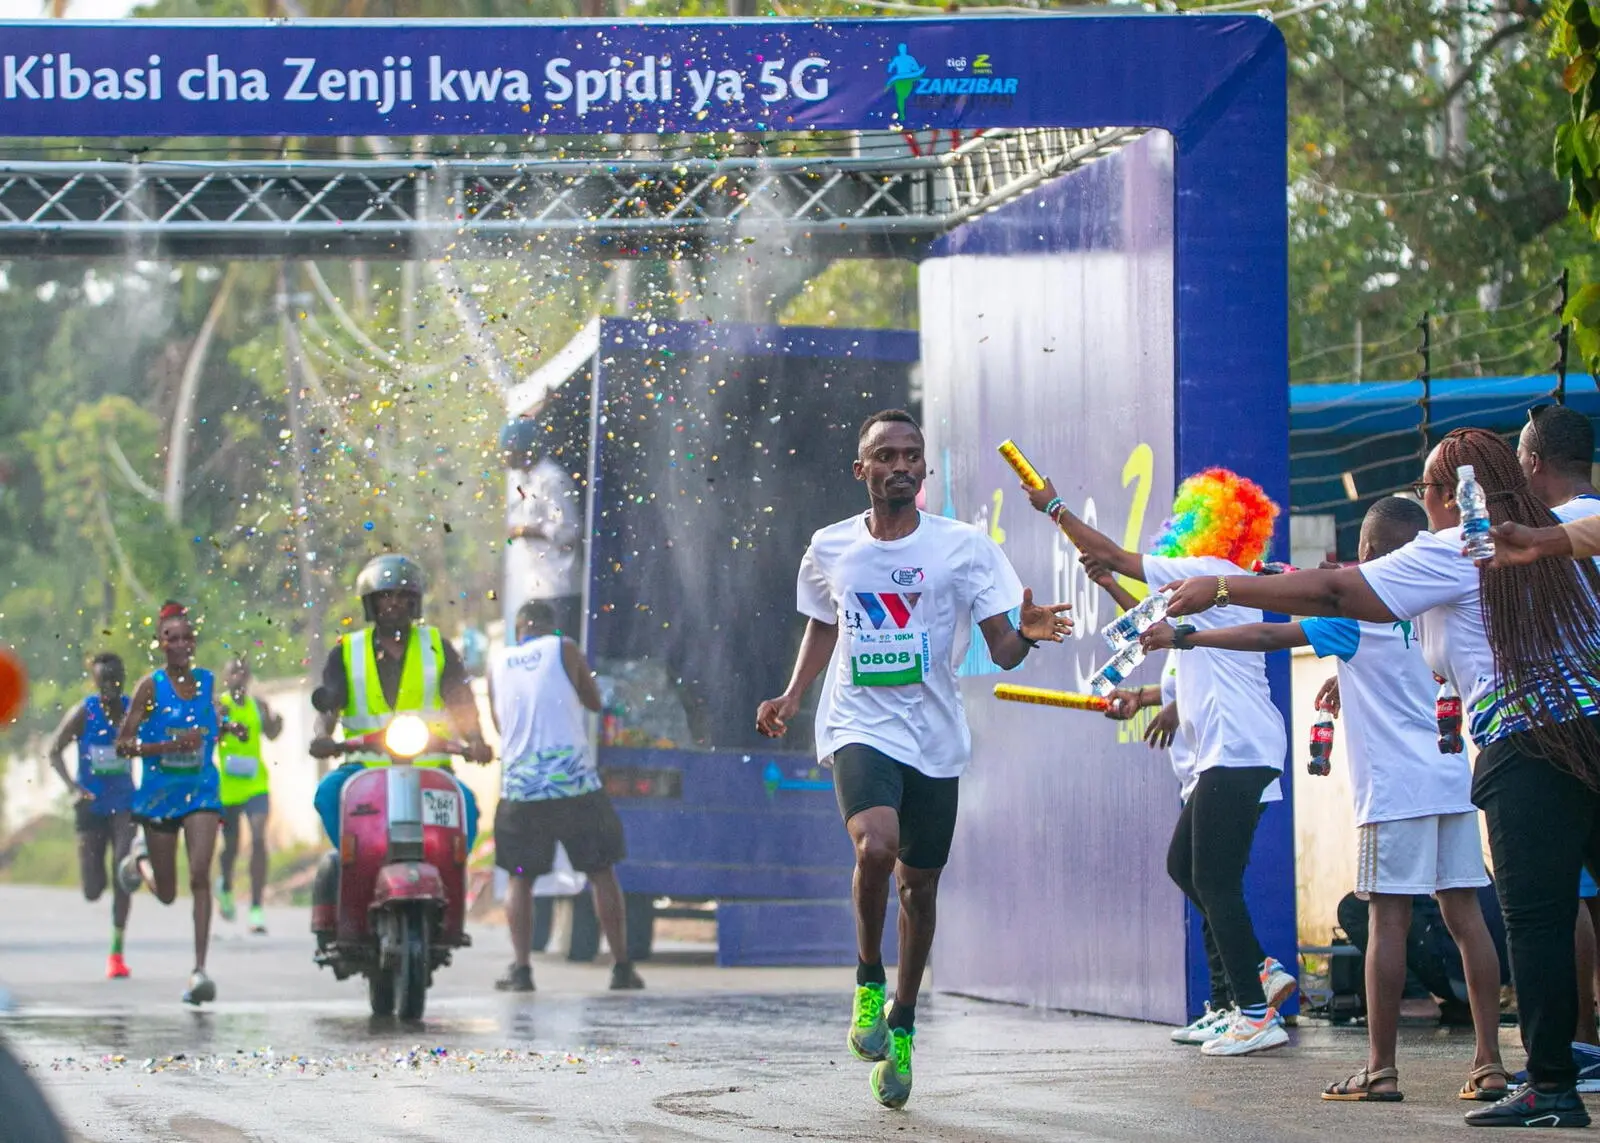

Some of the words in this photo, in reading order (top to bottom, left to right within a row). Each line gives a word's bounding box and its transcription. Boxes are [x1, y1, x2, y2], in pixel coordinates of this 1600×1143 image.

[4, 53, 162, 100] Kibasi
[177, 54, 270, 101] cha
[283, 55, 413, 114] Zenji
[429, 55, 532, 101] kwa
[545, 55, 673, 116] Spidi
[688, 69, 745, 112] ya
[760, 57, 829, 102] 5G
[915, 78, 1018, 94] ZANZIBAR
[895, 633, 914, 641] 10KM
[859, 651, 911, 665] 0808
